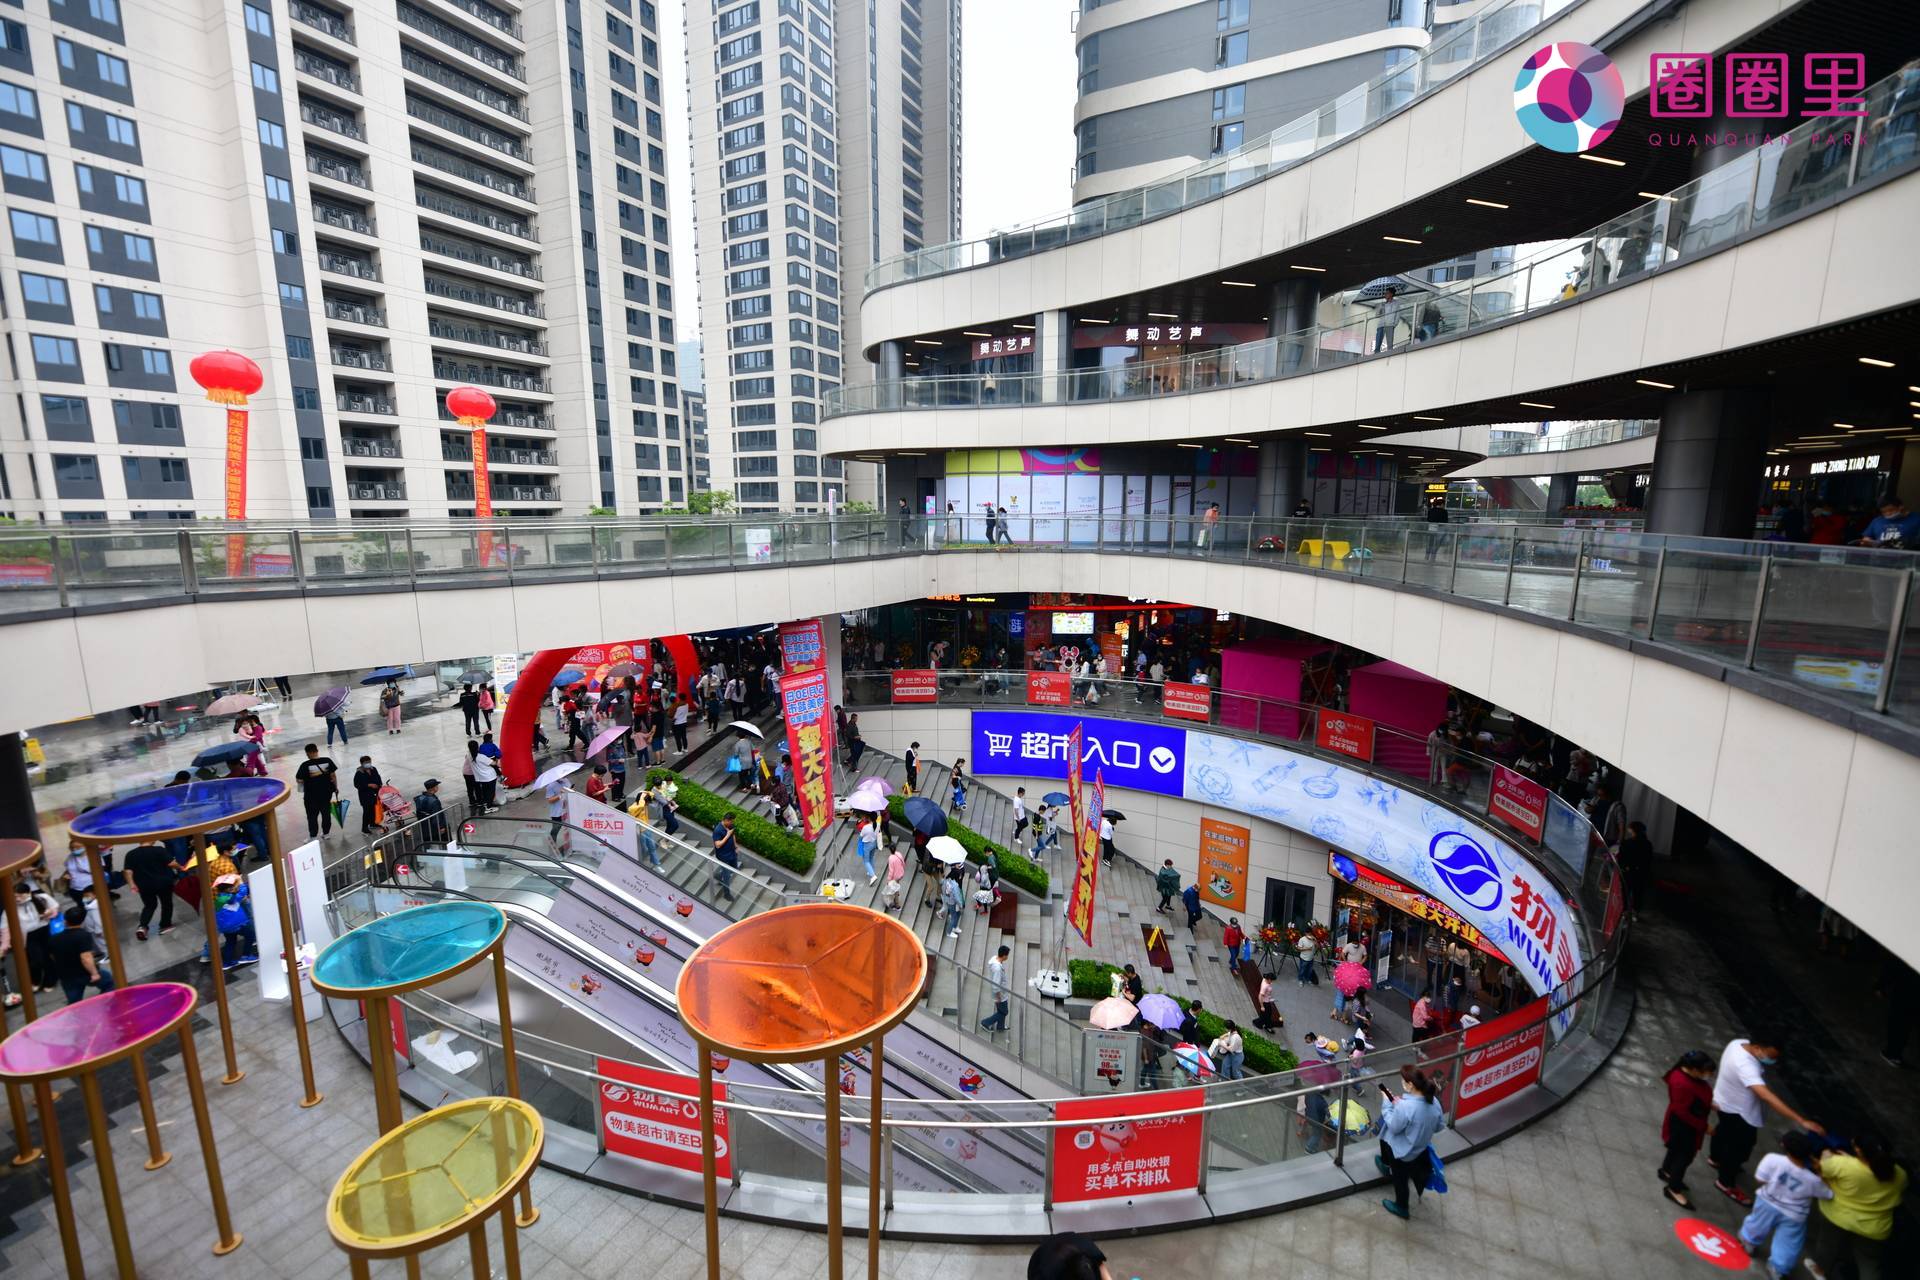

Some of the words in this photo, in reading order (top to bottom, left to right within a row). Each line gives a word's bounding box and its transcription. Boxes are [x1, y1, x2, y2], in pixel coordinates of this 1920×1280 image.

[1848, 456, 1865, 471] XIAO
[1020, 731, 1140, 769] 超市入口
[583, 818, 624, 830] 超市入口
[1412, 900, 1479, 944] 盛大开业
[633, 1100, 680, 1115] WUMART
[610, 1116, 702, 1148] 物美超市请至B
[1087, 1156, 1170, 1175] 用多点自助收银
[1085, 1169, 1171, 1192] 买单不排队
